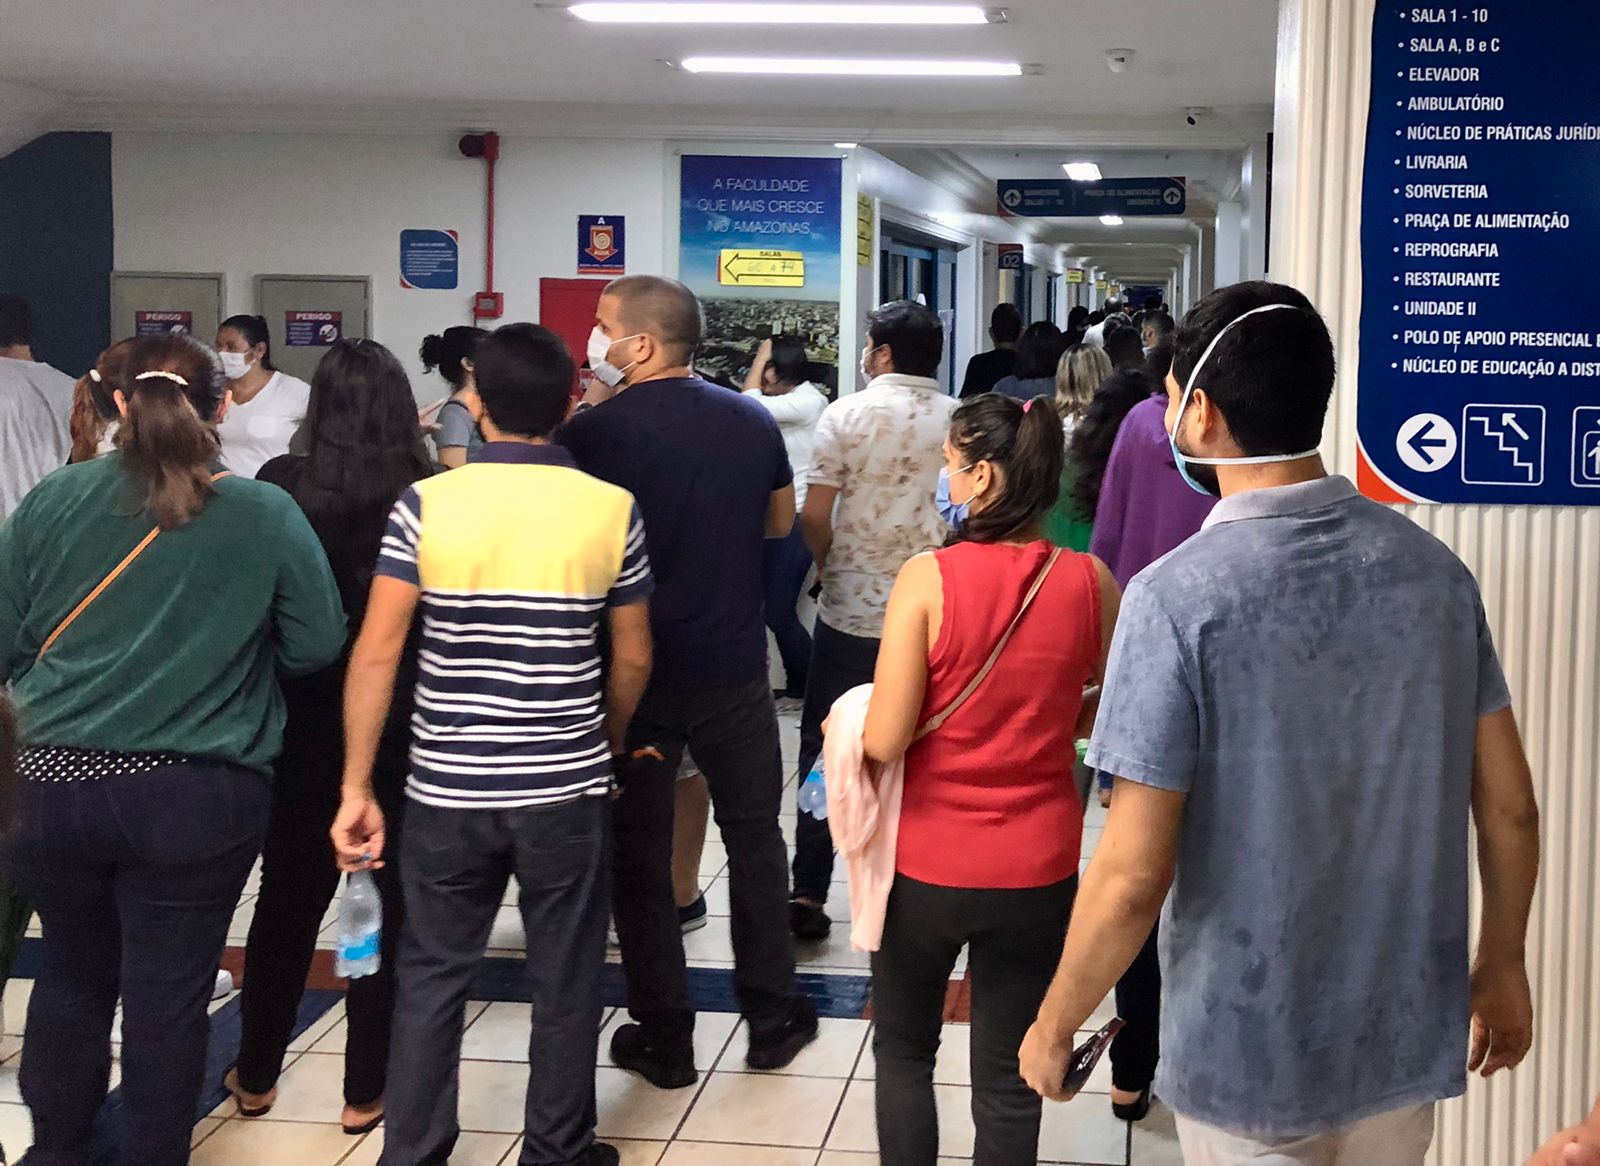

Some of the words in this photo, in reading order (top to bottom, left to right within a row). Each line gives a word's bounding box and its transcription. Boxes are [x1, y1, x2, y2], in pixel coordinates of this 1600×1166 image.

[1412, 9, 1445, 22] SALA
[1451, 9, 1456, 22] 1
[1472, 9, 1487, 22] 10
[1411, 38, 1444, 52] SALA
[1448, 39, 1461, 53] A,
[1466, 39, 1474, 52] B
[1479, 41, 1486, 52] e
[1491, 38, 1499, 52] C
[1410, 68, 1479, 81] ELEVADOR
[1408, 94, 1504, 110] AMBULATÓRIO
[1408, 123, 1460, 140] NÚCLEO
[1465, 126, 1482, 140] DE
[1487, 123, 1552, 140] PRÁTICAS
[1407, 156, 1467, 169] LIVRARIA
[714, 178, 722, 189] A
[727, 179, 809, 192] FACULDADE
[1405, 184, 1488, 198] SORVETERIA
[698, 198, 727, 211] QUE
[731, 199, 765, 212] MAIS
[768, 201, 824, 213] CRESCE
[597, 216, 606, 225] A
[707, 221, 728, 232] NO
[733, 222, 809, 234] AMAZONAS
[1405, 214, 1449, 231] PRAÇA
[1454, 214, 1471, 227] DE
[1475, 211, 1569, 232] ALIMENTAÇÃO
[1405, 243, 1498, 257] REPROGRAFIA
[1002, 255, 1020, 268] 02
[1405, 272, 1500, 286] RESTAURANTE
[1405, 301, 1463, 315] UNIDADE
[1468, 302, 1476, 315] II
[145, 313, 182, 321] PERIGO
[295, 312, 333, 320] PERIGO
[1405, 330, 1439, 344] POLO
[1444, 331, 1460, 345] DE
[1465, 331, 1505, 345] APOIO
[1510, 332, 1592, 347] PRESENCIAL
[1403, 356, 1456, 373] NÚCLEO
[1461, 360, 1478, 373] DE
[1482, 359, 1554, 378] EDUCAÇÃO
[1558, 362, 1567, 375] A
